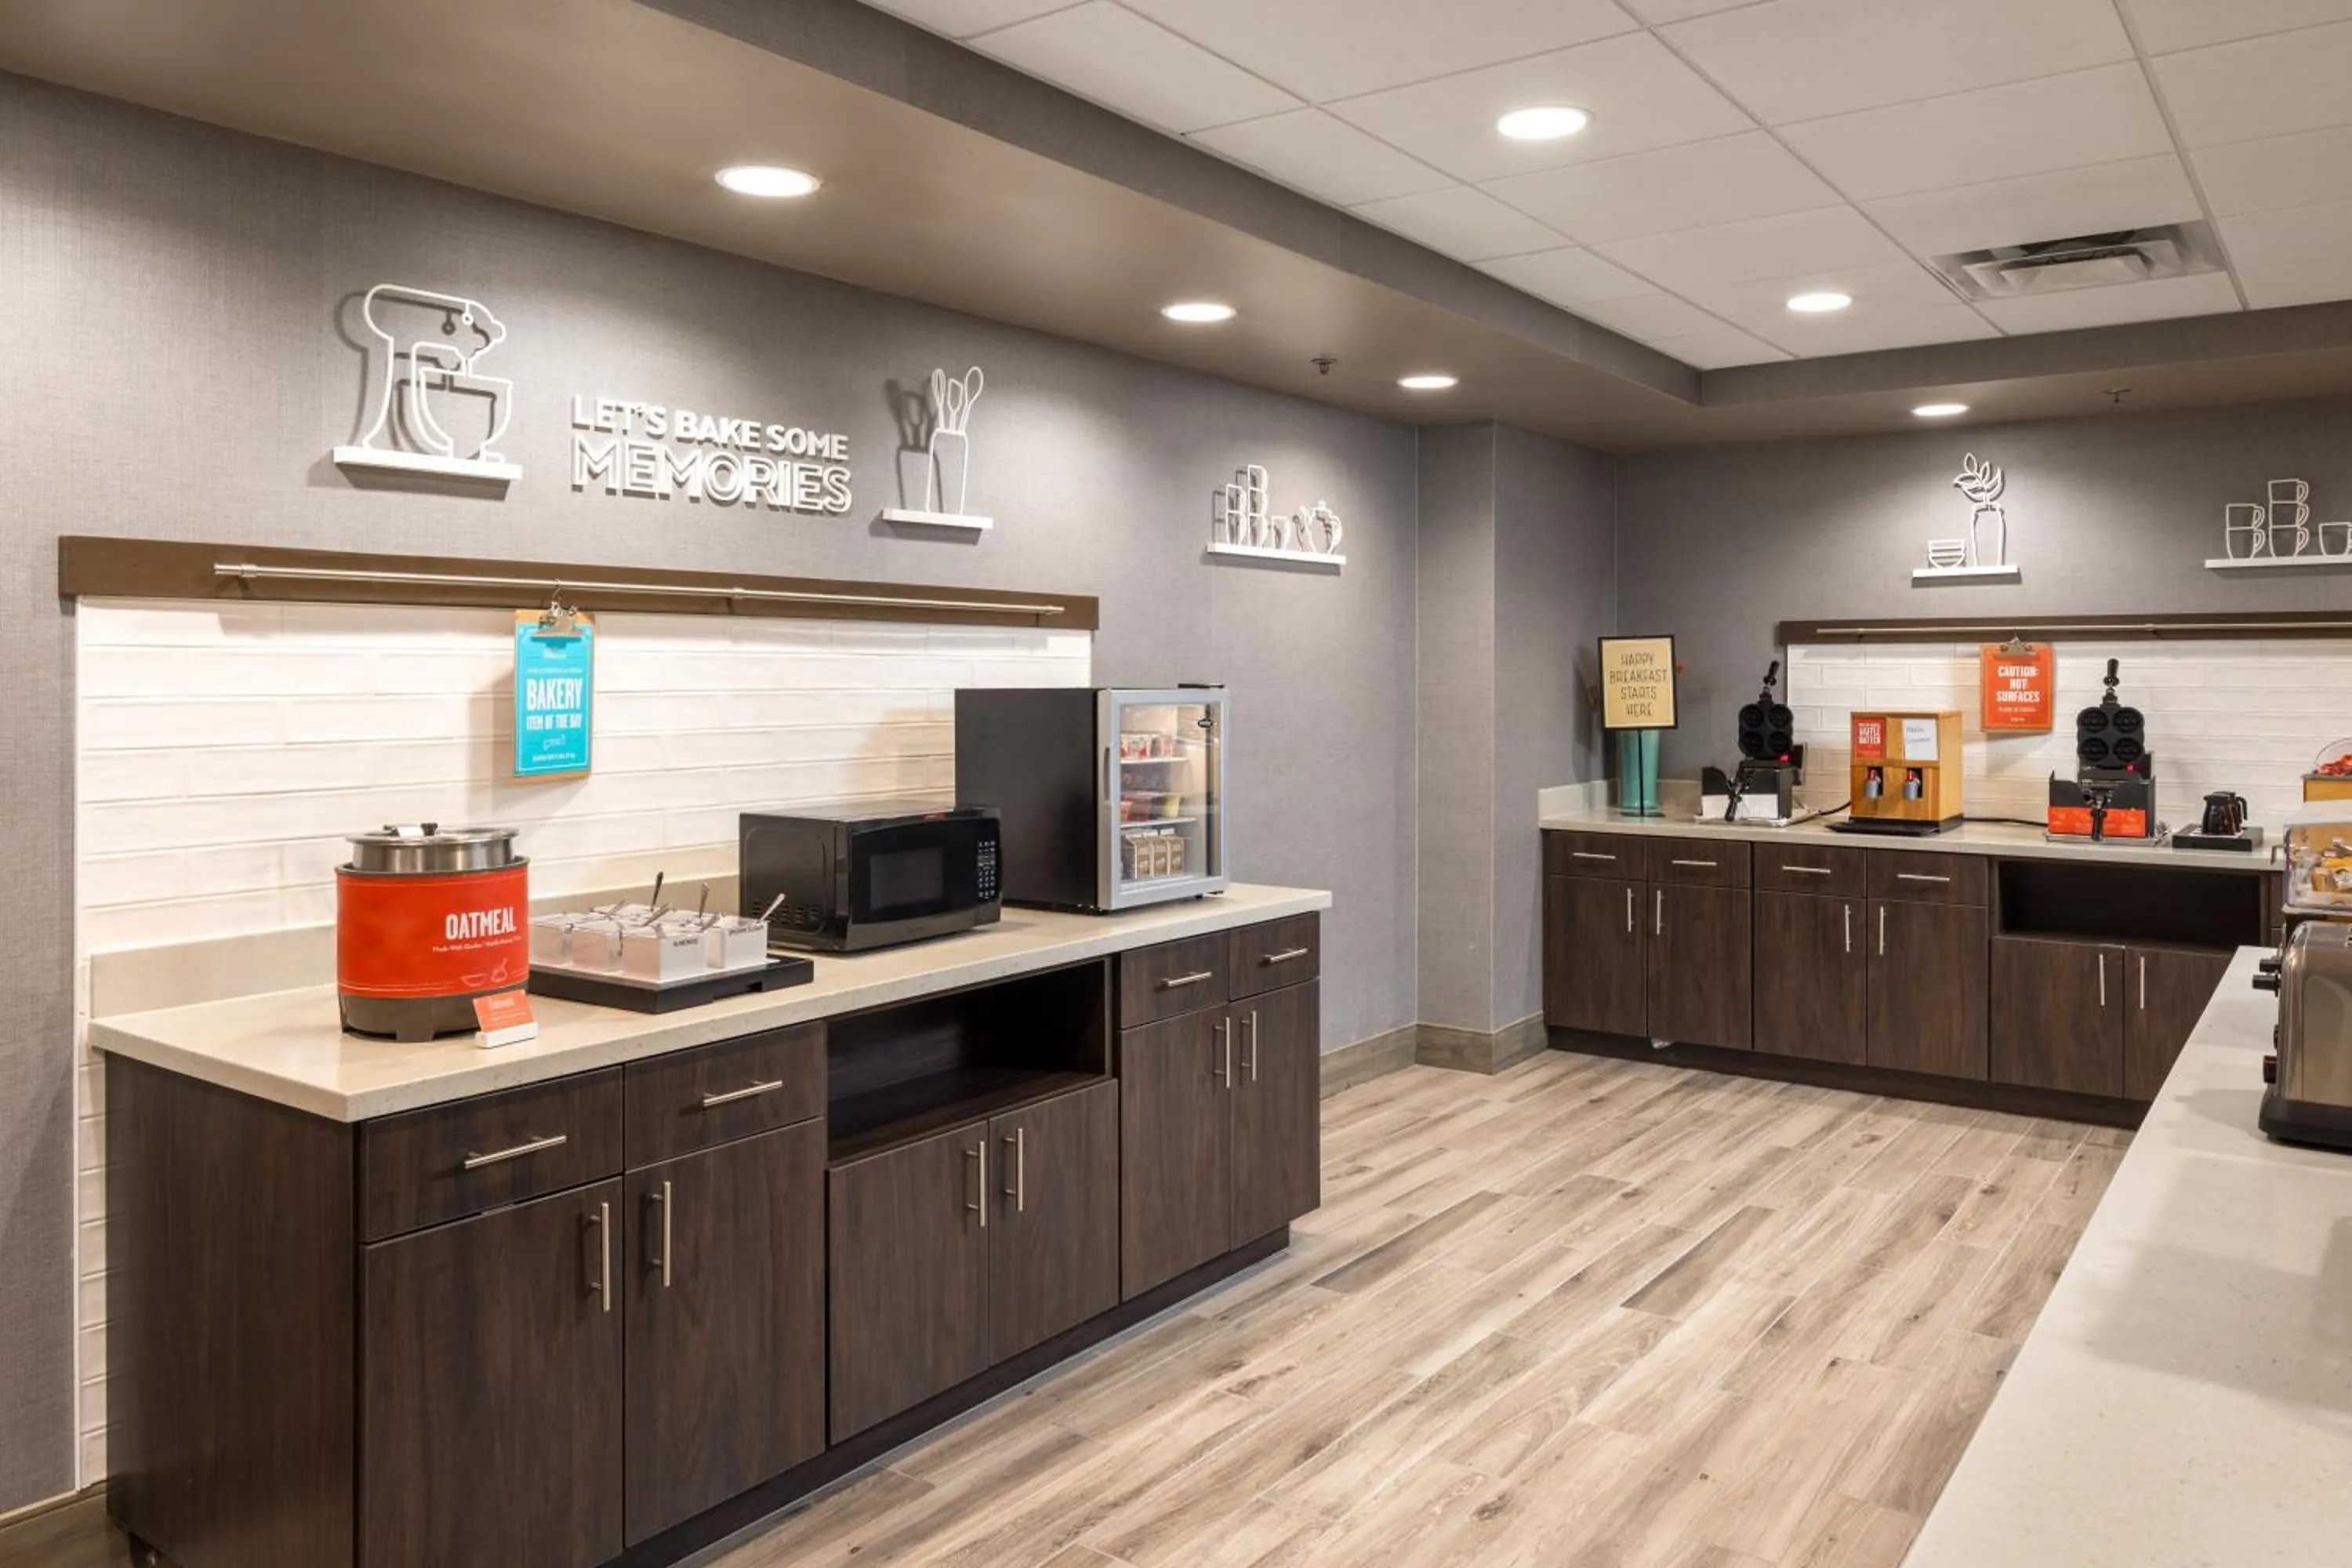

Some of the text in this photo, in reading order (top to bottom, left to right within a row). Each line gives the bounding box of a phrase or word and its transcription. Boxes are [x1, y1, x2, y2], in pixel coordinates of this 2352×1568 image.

[572, 394, 849, 461] LET'S BAKE SOME
[572, 434, 852, 513] MEMORIES
[1621, 652, 1655, 666] HAPPY
[1610, 669, 1667, 684] BREAKFAST
[2009, 678, 2028, 690] HOT
[526, 678, 583, 711] BAKERY
[1621, 686, 1657, 700] STARTS
[1996, 691, 2040, 702] SURFACES
[1626, 702, 1653, 717] HERE
[445, 906, 517, 940] OATMEAL
